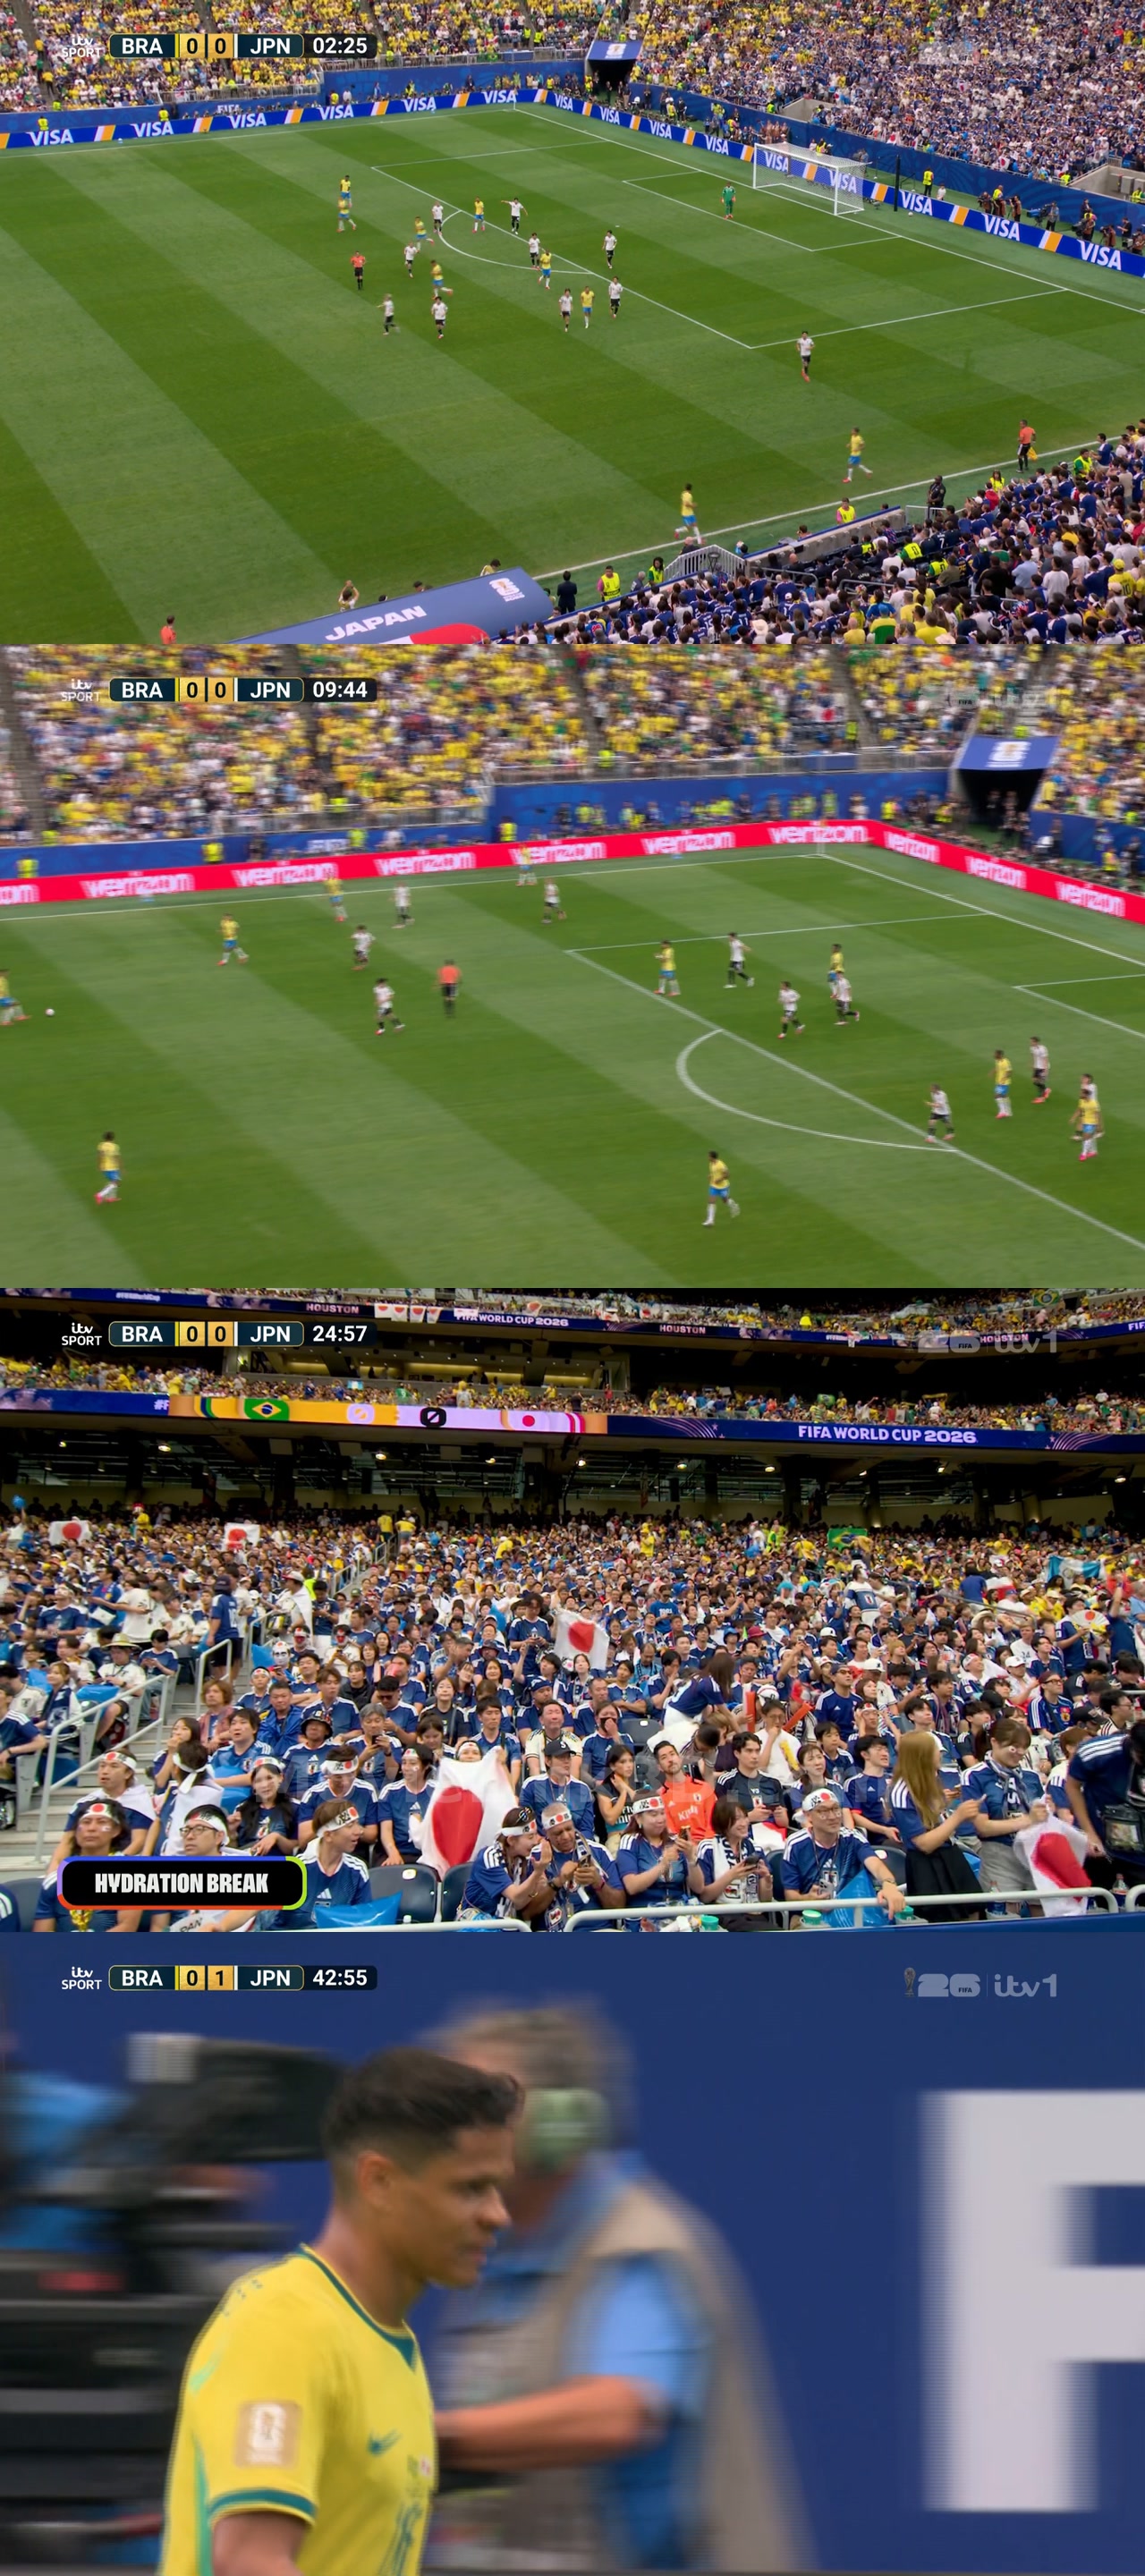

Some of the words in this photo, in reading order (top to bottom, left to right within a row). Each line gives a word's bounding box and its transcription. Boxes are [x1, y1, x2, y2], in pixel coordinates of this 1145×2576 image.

[403, 97, 436, 113] VISA
[482, 89, 516, 104] VISA
[555, 93, 573, 112] VISA
[227, 112, 267, 130] VISA
[319, 105, 354, 121] VISA
[599, 106, 620, 125] VISA
[26, 128, 73, 147] VISA
[131, 121, 174, 139] VISA
[649, 120, 672, 140] VISA
[705, 135, 729, 156] VISA
[898, 189, 933, 216] VISA
[981, 212, 1020, 242] VISA
[1077, 239, 1122, 270] VISA
[326, 606, 428, 641] JAPAN
[768, 819, 868, 843] verizon
[641, 829, 735, 855] verizon
[884, 832, 939, 863] verizon
[375, 850, 476, 877] verizon
[305, 1303, 360, 1315] HOUSTON
[477, 1314, 514, 1325] WORLD
[514, 1316, 534, 1326] CUP
[535, 1317, 569, 1327] 2026
[659, 1324, 706, 1335] HOUSTON
[980, 1333, 1029, 1343] HOUSTON
[798, 1425, 832, 1439] FIFA
[833, 1426, 889, 1441] WORLD
[891, 1428, 922, 1442] CUP
[924, 1429, 977, 1444] 2026
